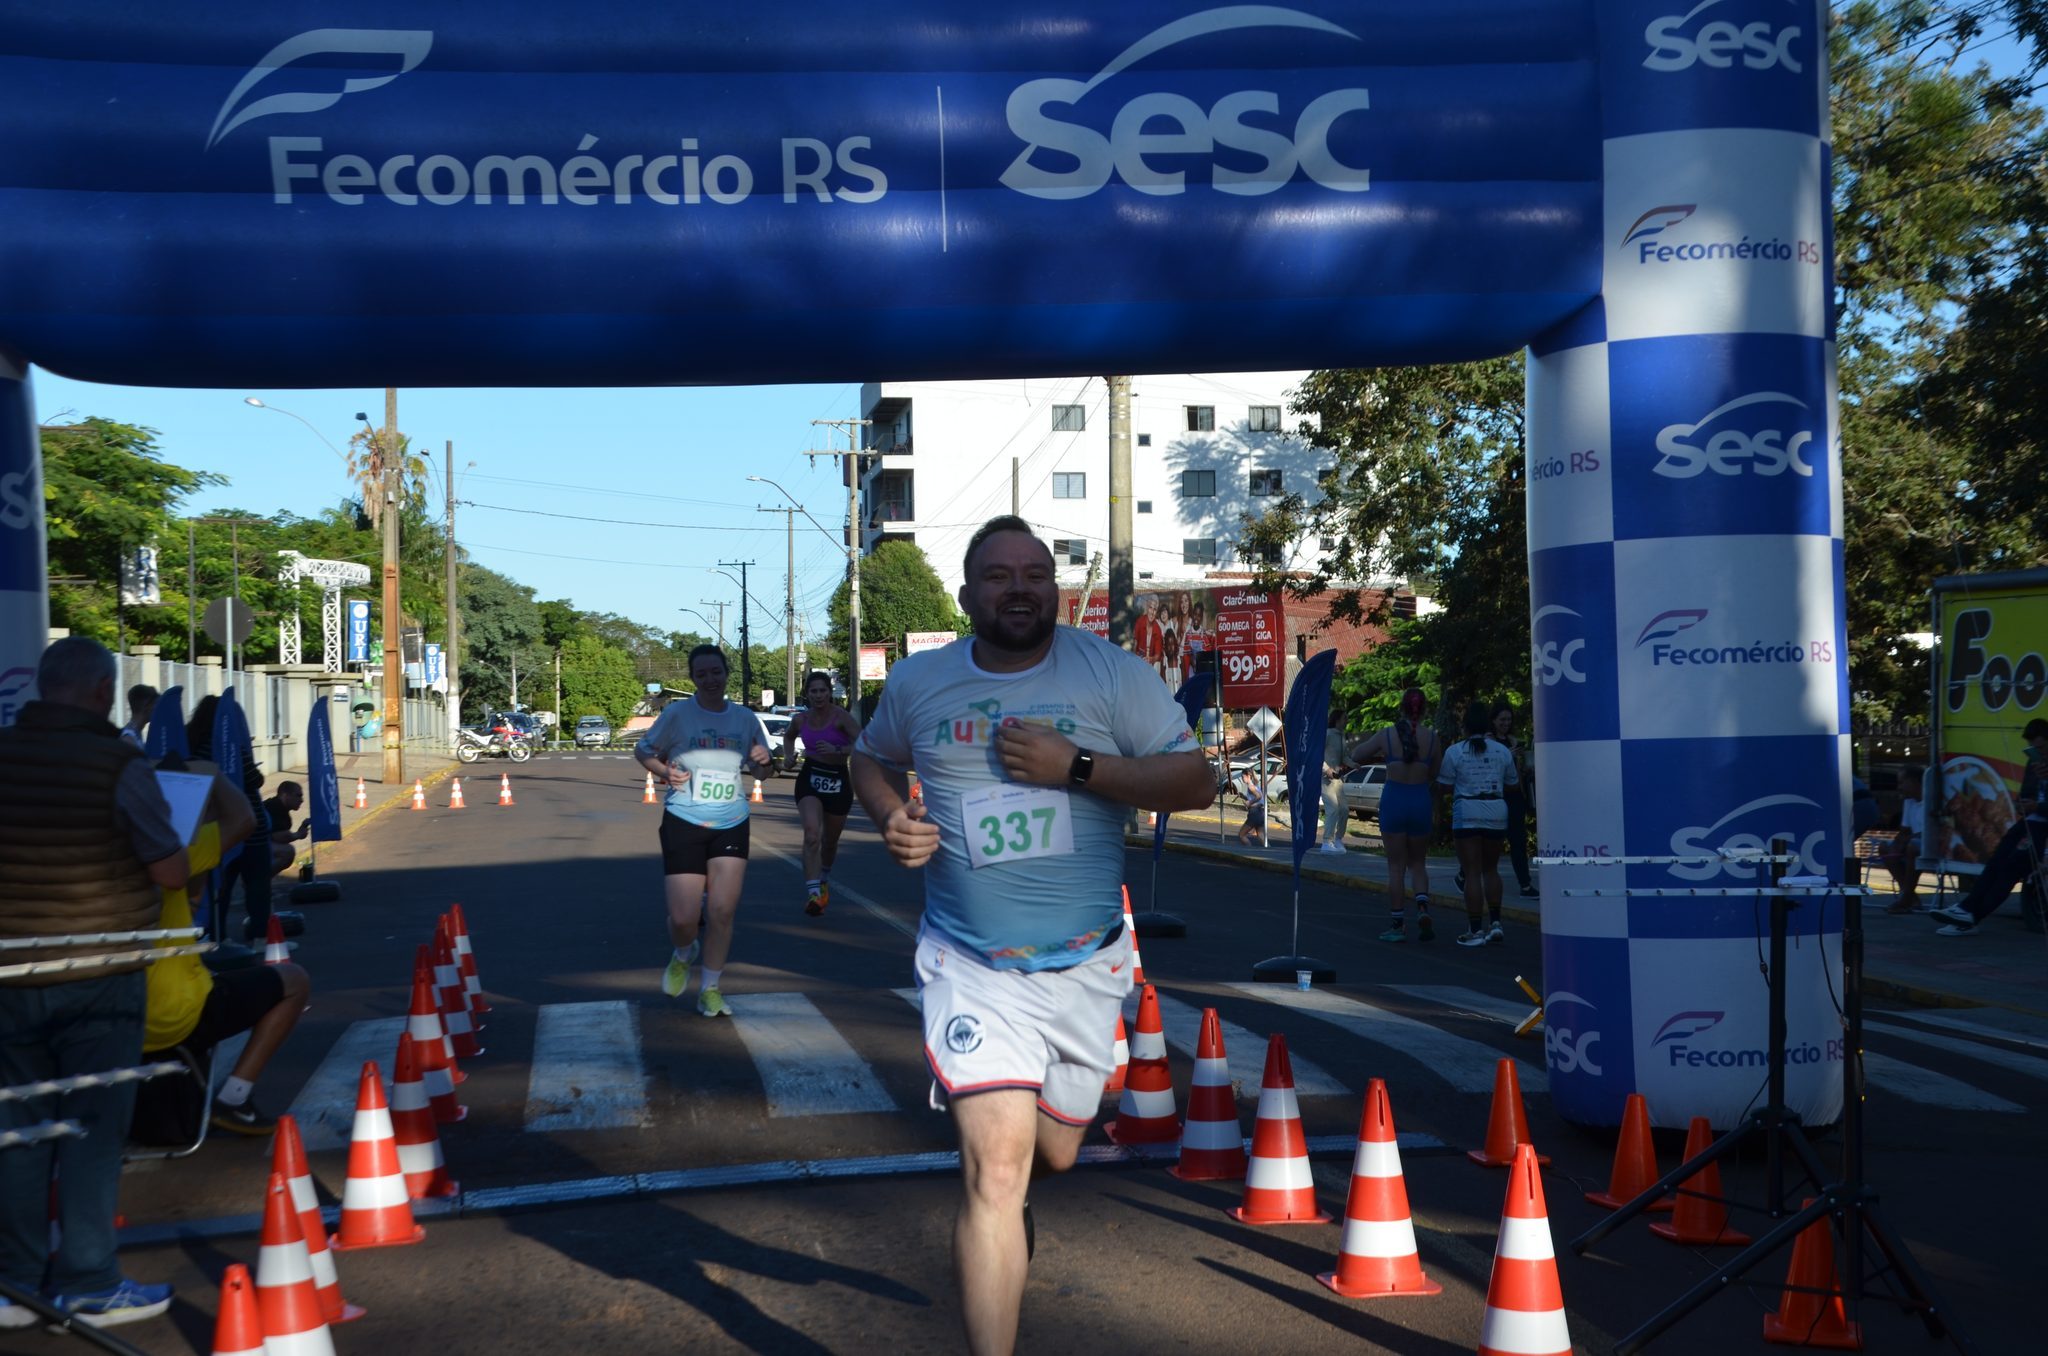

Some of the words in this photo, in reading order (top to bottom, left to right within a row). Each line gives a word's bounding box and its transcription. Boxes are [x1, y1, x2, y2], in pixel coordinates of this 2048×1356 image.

[1642, 14, 1802, 74] Sesc
[998, 77, 1371, 200] Sesc
[268, 134, 754, 206] Fecomércio
[781, 135, 888, 204] RS
[1639, 236, 1792, 264] Fecomércio
[1797, 240, 1820, 265] RS
[1570, 449, 1601, 474] RS
[1652, 423, 1814, 479] Sesc
[1218, 622, 1231, 632] 600
[1231, 621, 1250, 631] MEGA
[1255, 620, 1265, 630] 60
[1255, 631, 1272, 640] GIGA
[353, 619, 370, 659] URI
[1652, 641, 1805, 666] Fecomércio
[1810, 641, 1832, 663] RS
[700, 781, 736, 801] 509
[813, 777, 838, 791] 662
[979, 806, 1057, 857] 337
[1666, 826, 1828, 881] Sesc
[1669, 1042, 1822, 1067] Fecomrcio
